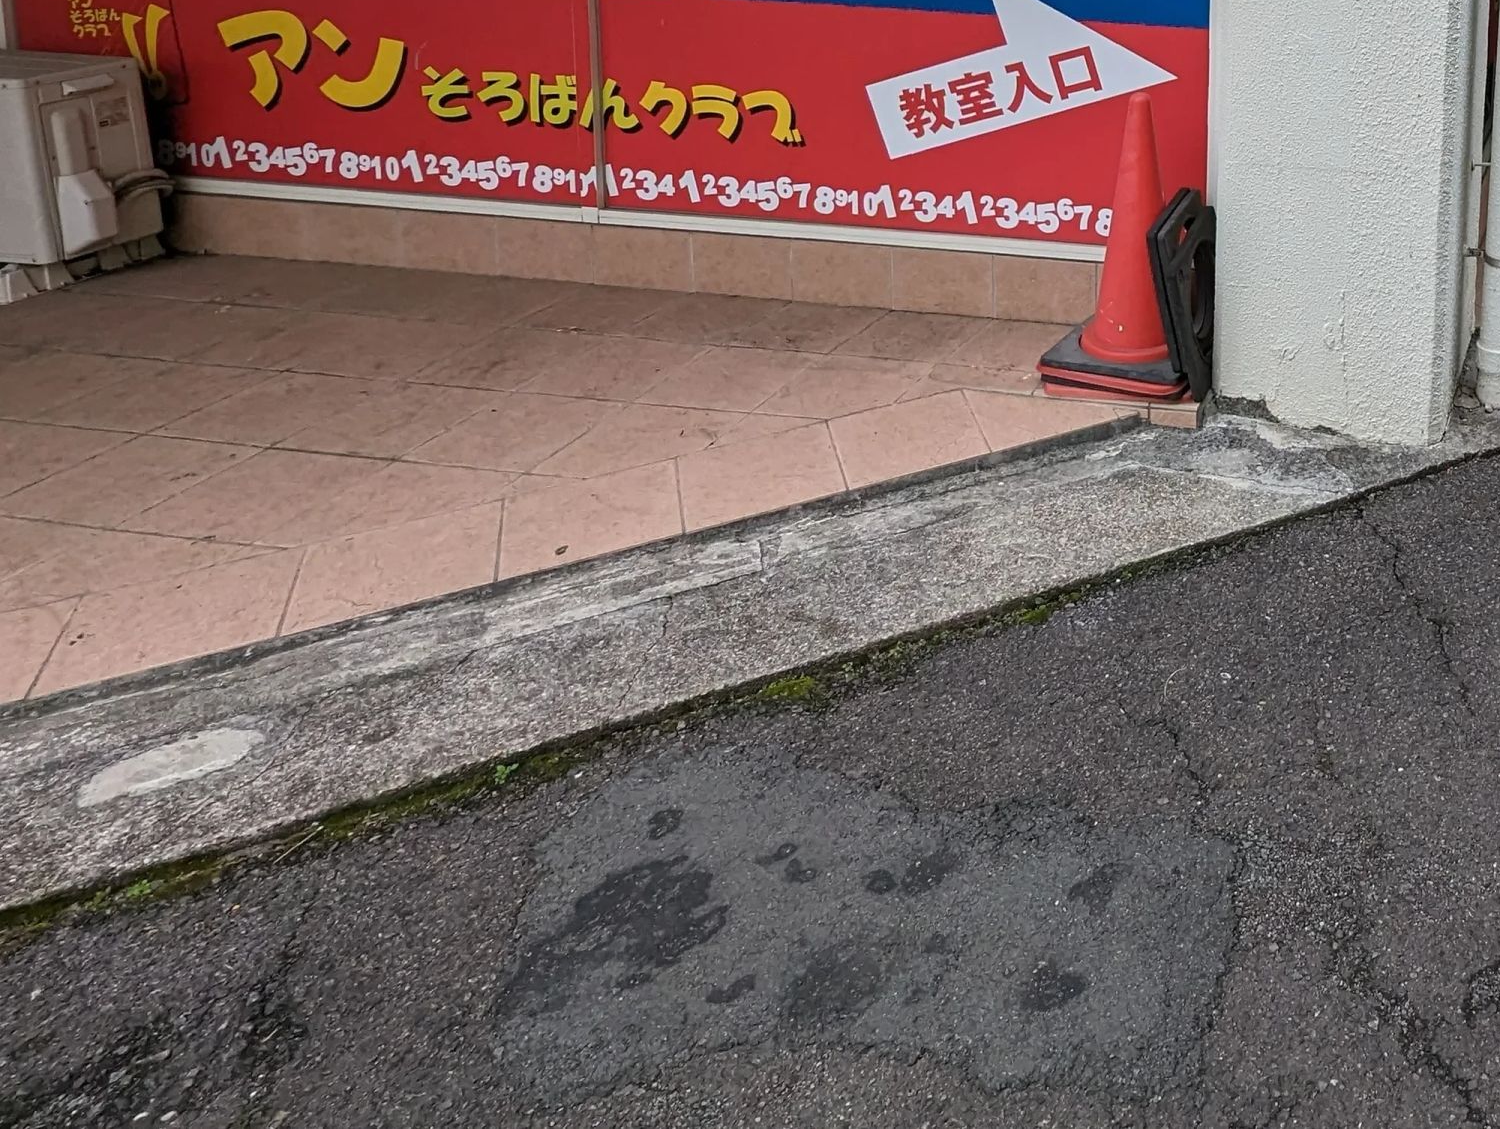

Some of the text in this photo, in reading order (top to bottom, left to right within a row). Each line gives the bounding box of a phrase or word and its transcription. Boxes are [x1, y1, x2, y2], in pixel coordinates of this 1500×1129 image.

[69, 8, 121, 23] そろばん
[898, 45, 1103, 139] 教室入口
